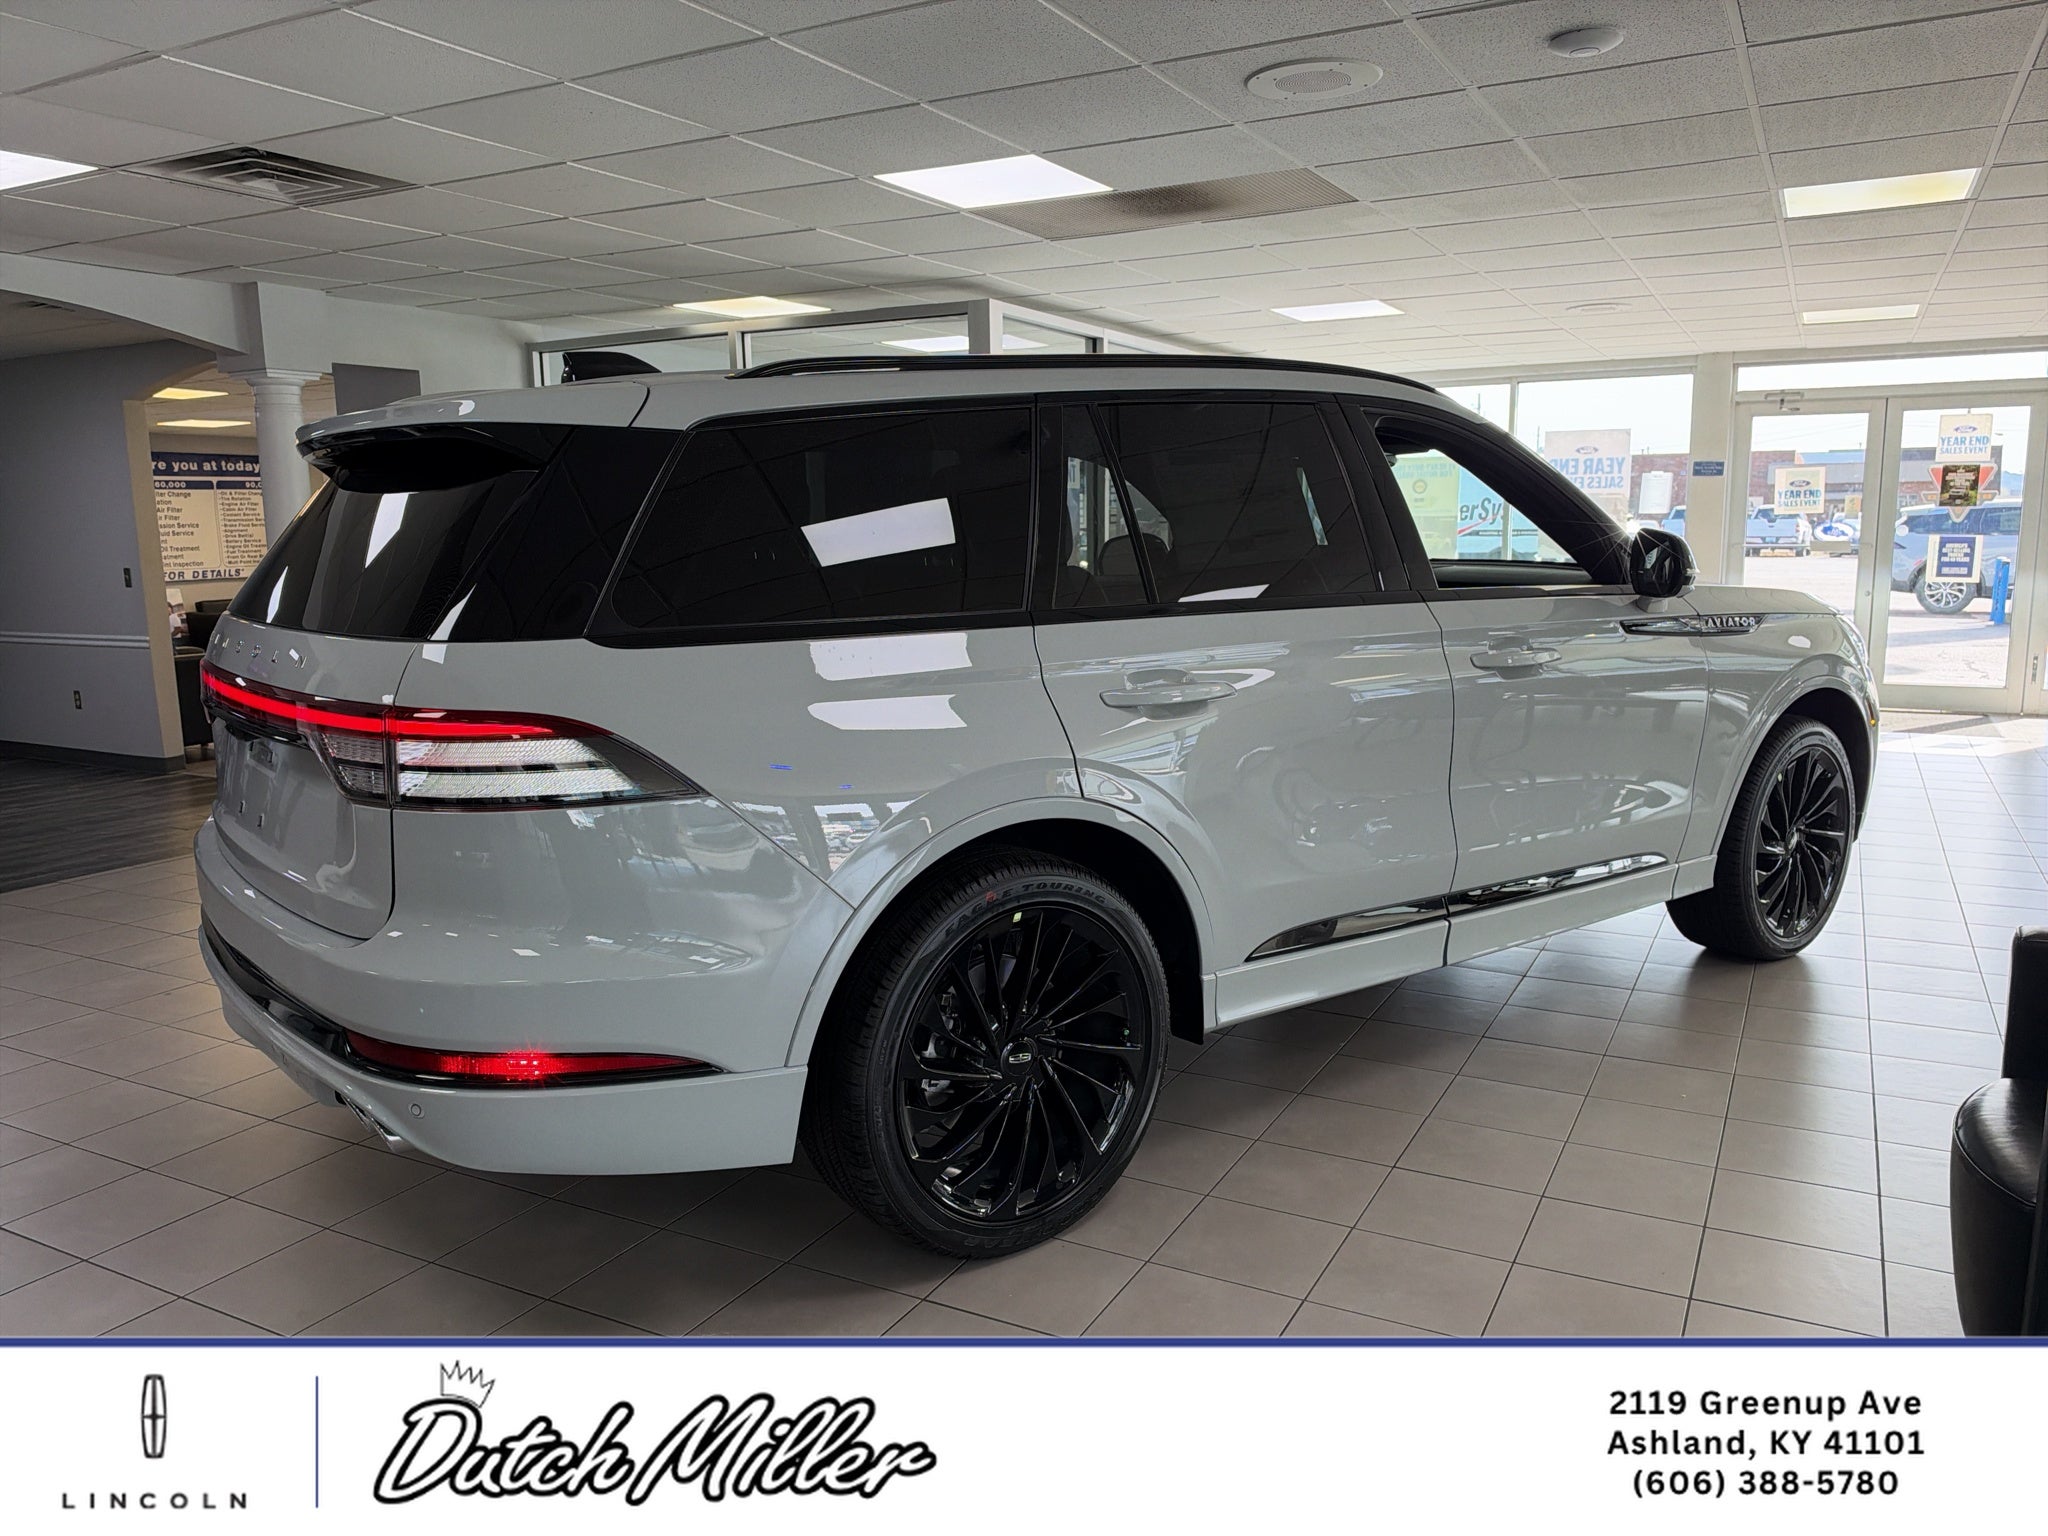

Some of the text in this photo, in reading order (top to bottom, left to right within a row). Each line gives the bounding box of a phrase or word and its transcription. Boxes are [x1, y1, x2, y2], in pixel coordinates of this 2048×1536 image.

[1940, 436, 1990, 446] YEAR END
[1964, 446, 1988, 454] EVENT
[172, 461, 198, 472] you
[202, 461, 218, 471] at
[221, 461, 260, 473] today
[154, 481, 187, 489] 60,000
[1778, 490, 1822, 499] YEAR END
[1460, 497, 1503, 525] erSy
[1707, 617, 1756, 629] AVIATOR
[1021, 882, 1108, 904] TOURING
